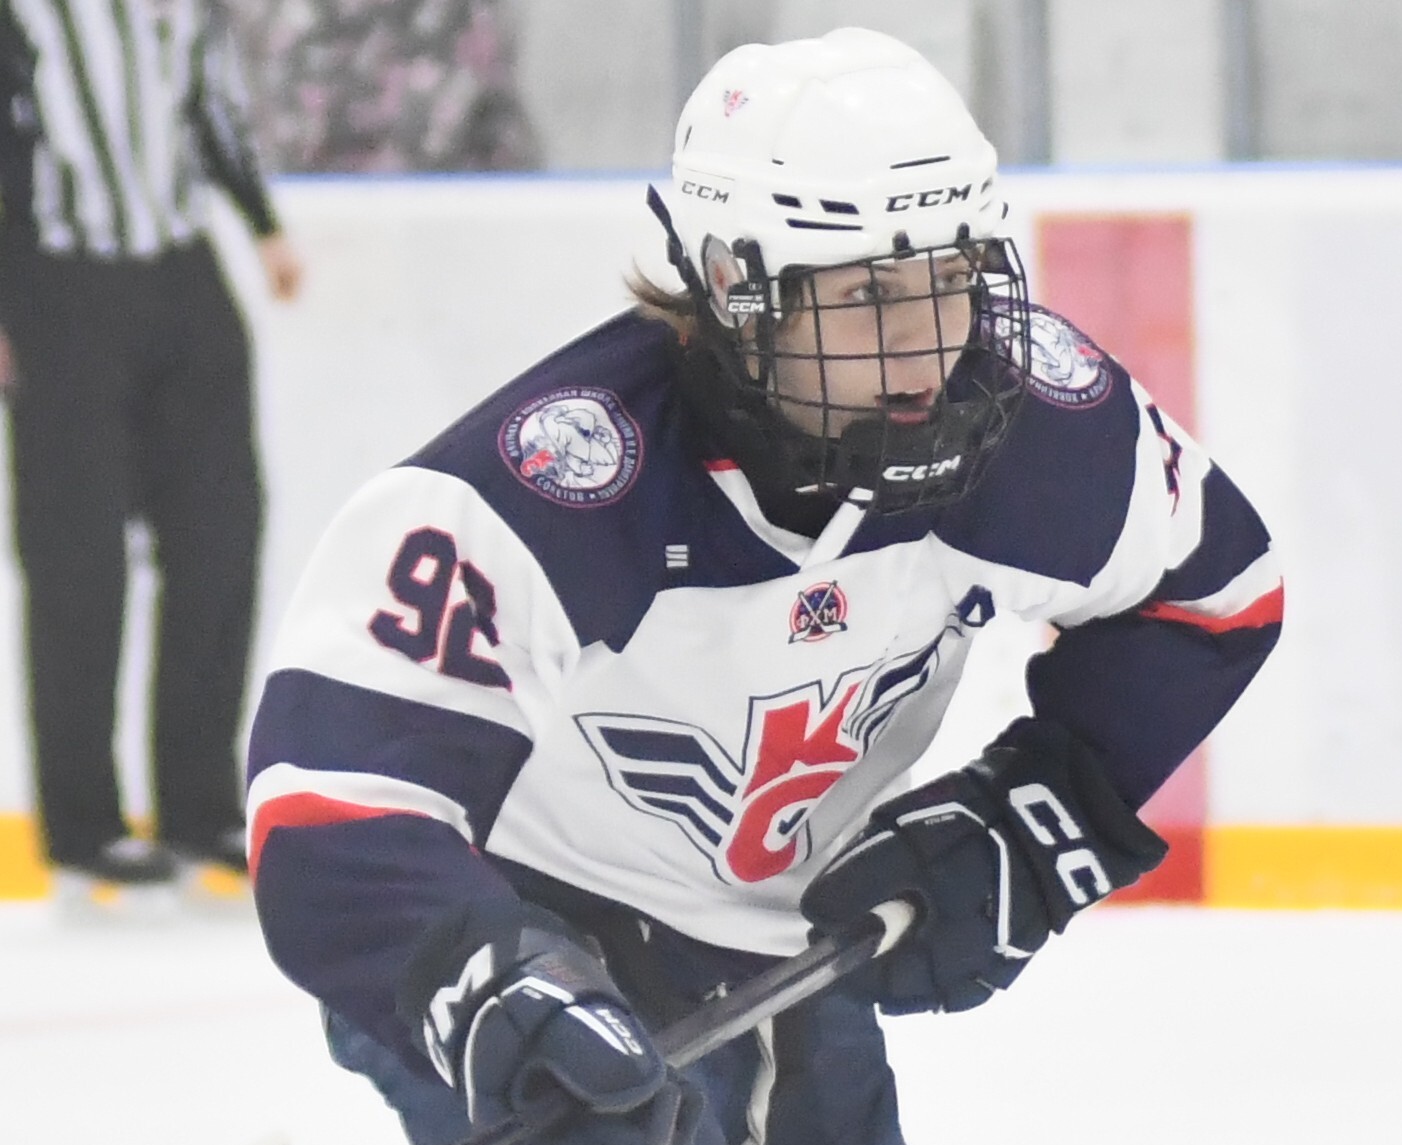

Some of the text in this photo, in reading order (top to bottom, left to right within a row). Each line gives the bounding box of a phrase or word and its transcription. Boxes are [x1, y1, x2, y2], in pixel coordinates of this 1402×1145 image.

[682, 181, 729, 204] CCM
[886, 184, 971, 212] CCM
[727, 302, 765, 313] CCM
[882, 454, 962, 481] CCM
[367, 525, 513, 693] 92
[1009, 783, 1113, 905] CC
